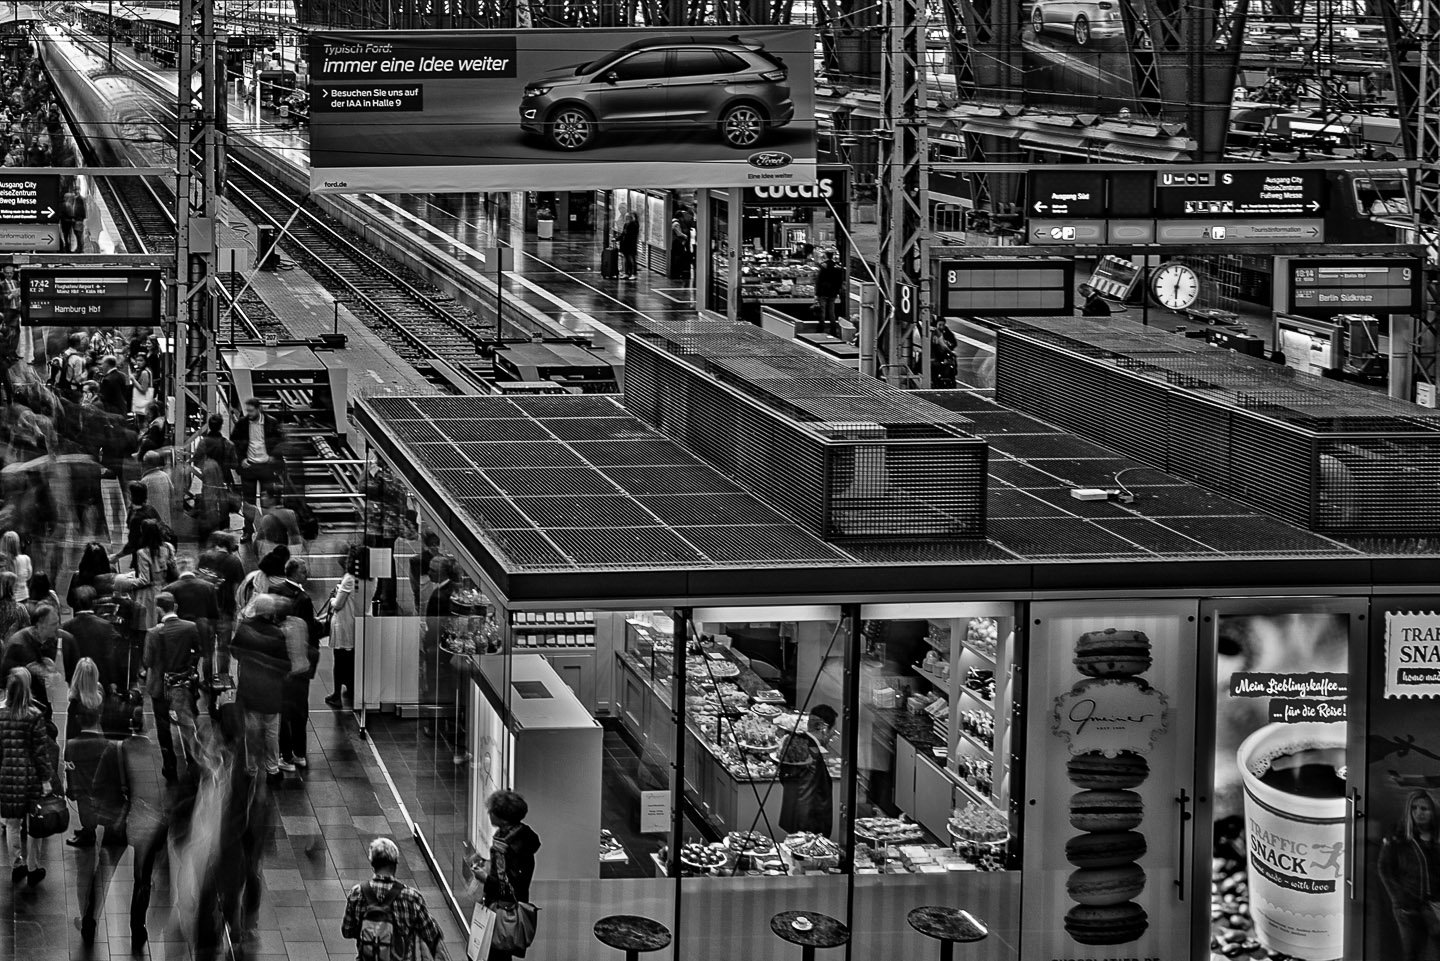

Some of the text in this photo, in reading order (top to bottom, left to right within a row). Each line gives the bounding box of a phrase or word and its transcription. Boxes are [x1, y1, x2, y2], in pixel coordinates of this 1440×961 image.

[323, 43, 393, 55] Typisch Ford:
[323, 56, 509, 73] immer eine Idee weiter
[331, 89, 372, 97] Besuchen
[373, 89, 387, 97] Sie
[404, 88, 419, 96] auf
[331, 99, 402, 108] der IAA in Halle 9
[757, 154, 784, 166] Ford
[1163, 173, 1233, 185] U S
[1291, 176, 1303, 184] City
[1051, 192, 1090, 201] Ausgang Süd
[948, 270, 957, 284] 8
[1402, 267, 1411, 281] 9
[30, 280, 50, 288] 17:42
[144, 278, 152, 292] 7
[901, 286, 910, 314] 8
[1319, 294, 1373, 302] Berlin Südkreuz
[54, 305, 101, 314] Hamburg Hbf
[1403, 671, 1424, 682] home
[1235, 678, 1348, 698] Mein Lieblingskaffee...
[1284, 703, 1347, 721] für die Reise!
[1250, 817, 1308, 856] TRAFFIC
[1251, 834, 1308, 875] SNACK
[1265, 871, 1329, 891] made with love
